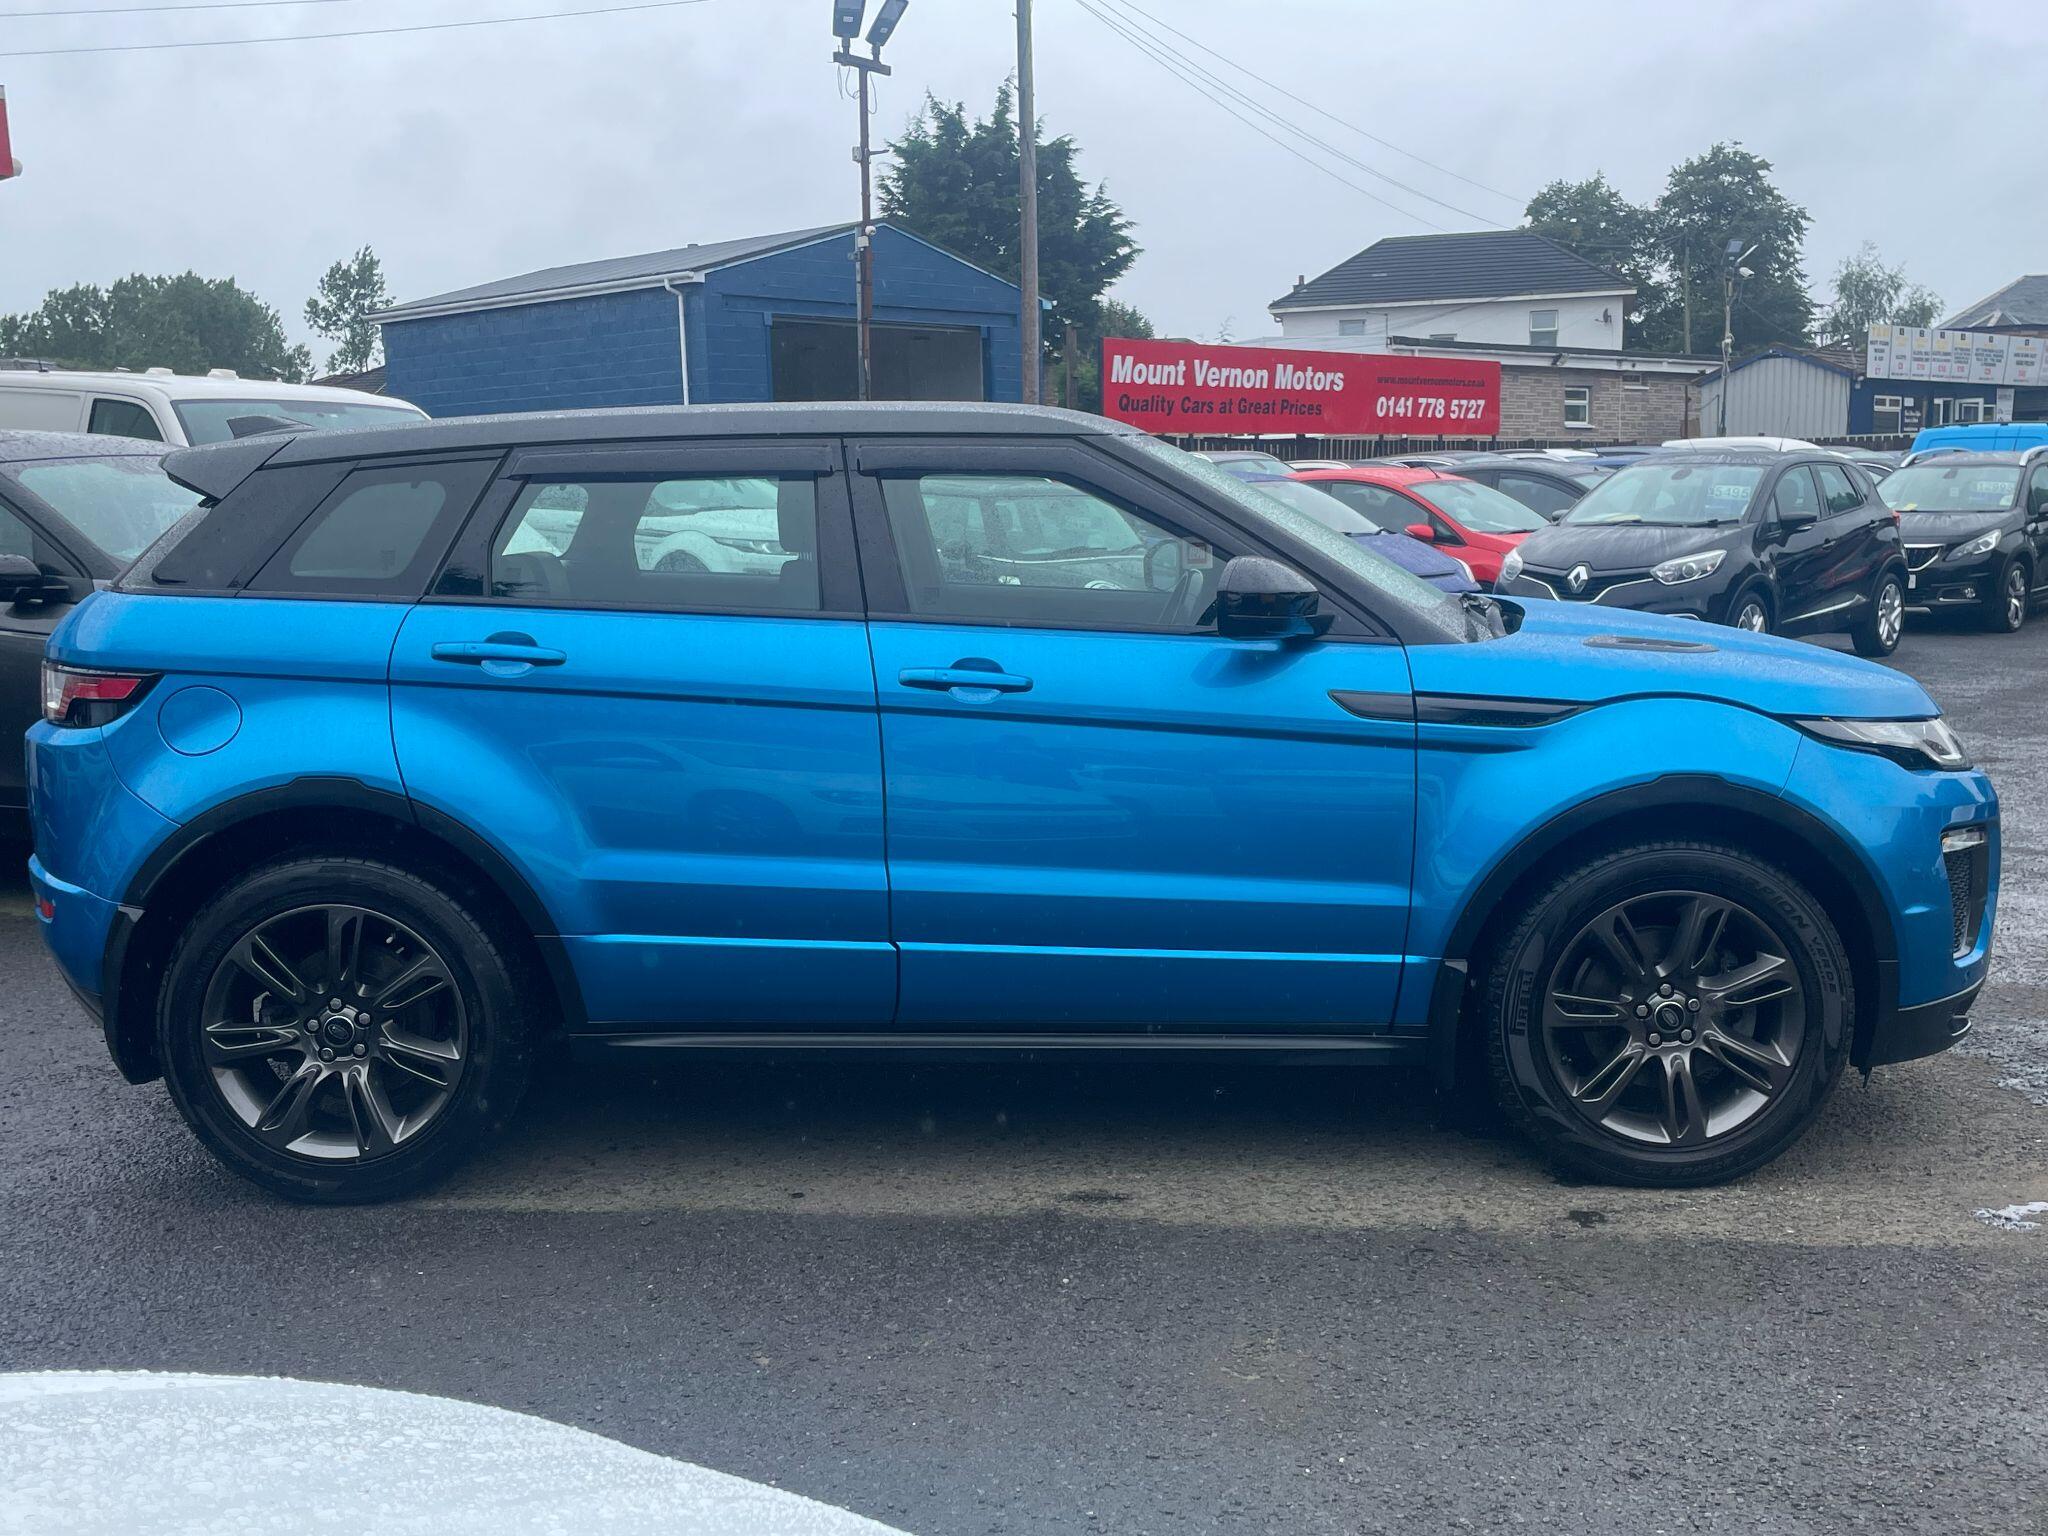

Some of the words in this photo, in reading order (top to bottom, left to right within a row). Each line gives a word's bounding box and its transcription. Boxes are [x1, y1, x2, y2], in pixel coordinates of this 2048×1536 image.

[1111, 355, 1186, 386] Mount
[1194, 359, 1268, 389] Vernon
[1274, 363, 1344, 392] Motors
[1119, 394, 1174, 416] Quality
[1181, 396, 1213, 414] Cars
[1219, 399, 1233, 415] at
[1238, 397, 1275, 415] Great
[1280, 399, 1322, 416] Prices
[1376, 396, 1413, 417] 0141
[1418, 398, 1445, 418] 778
[1450, 400, 1485, 419] 5727
